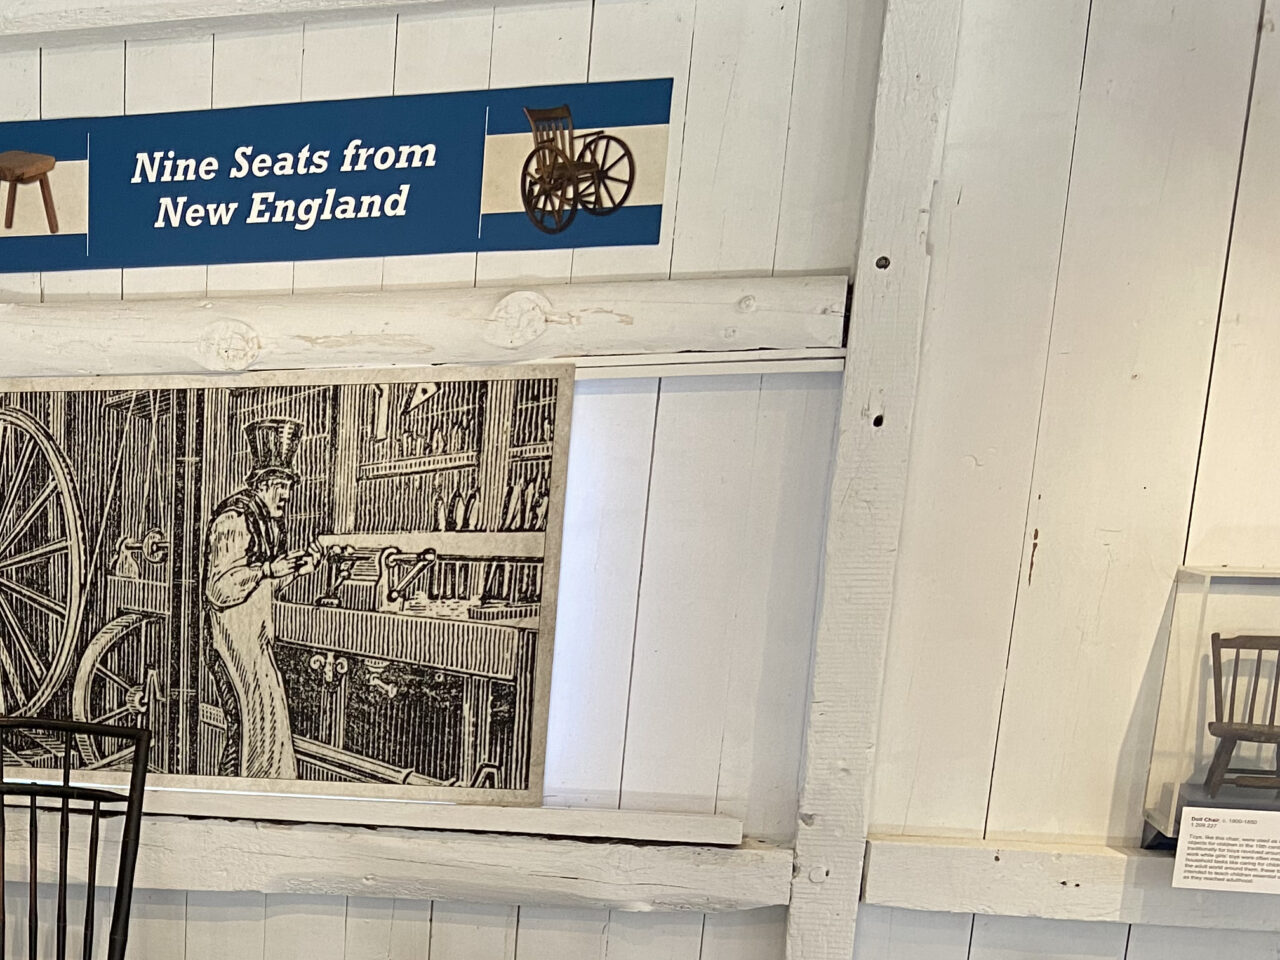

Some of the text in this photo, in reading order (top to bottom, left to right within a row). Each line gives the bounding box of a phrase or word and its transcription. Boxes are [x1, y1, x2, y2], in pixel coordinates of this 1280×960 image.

[131, 139, 436, 183] Nine Seats from
[154, 184, 410, 230] New England
